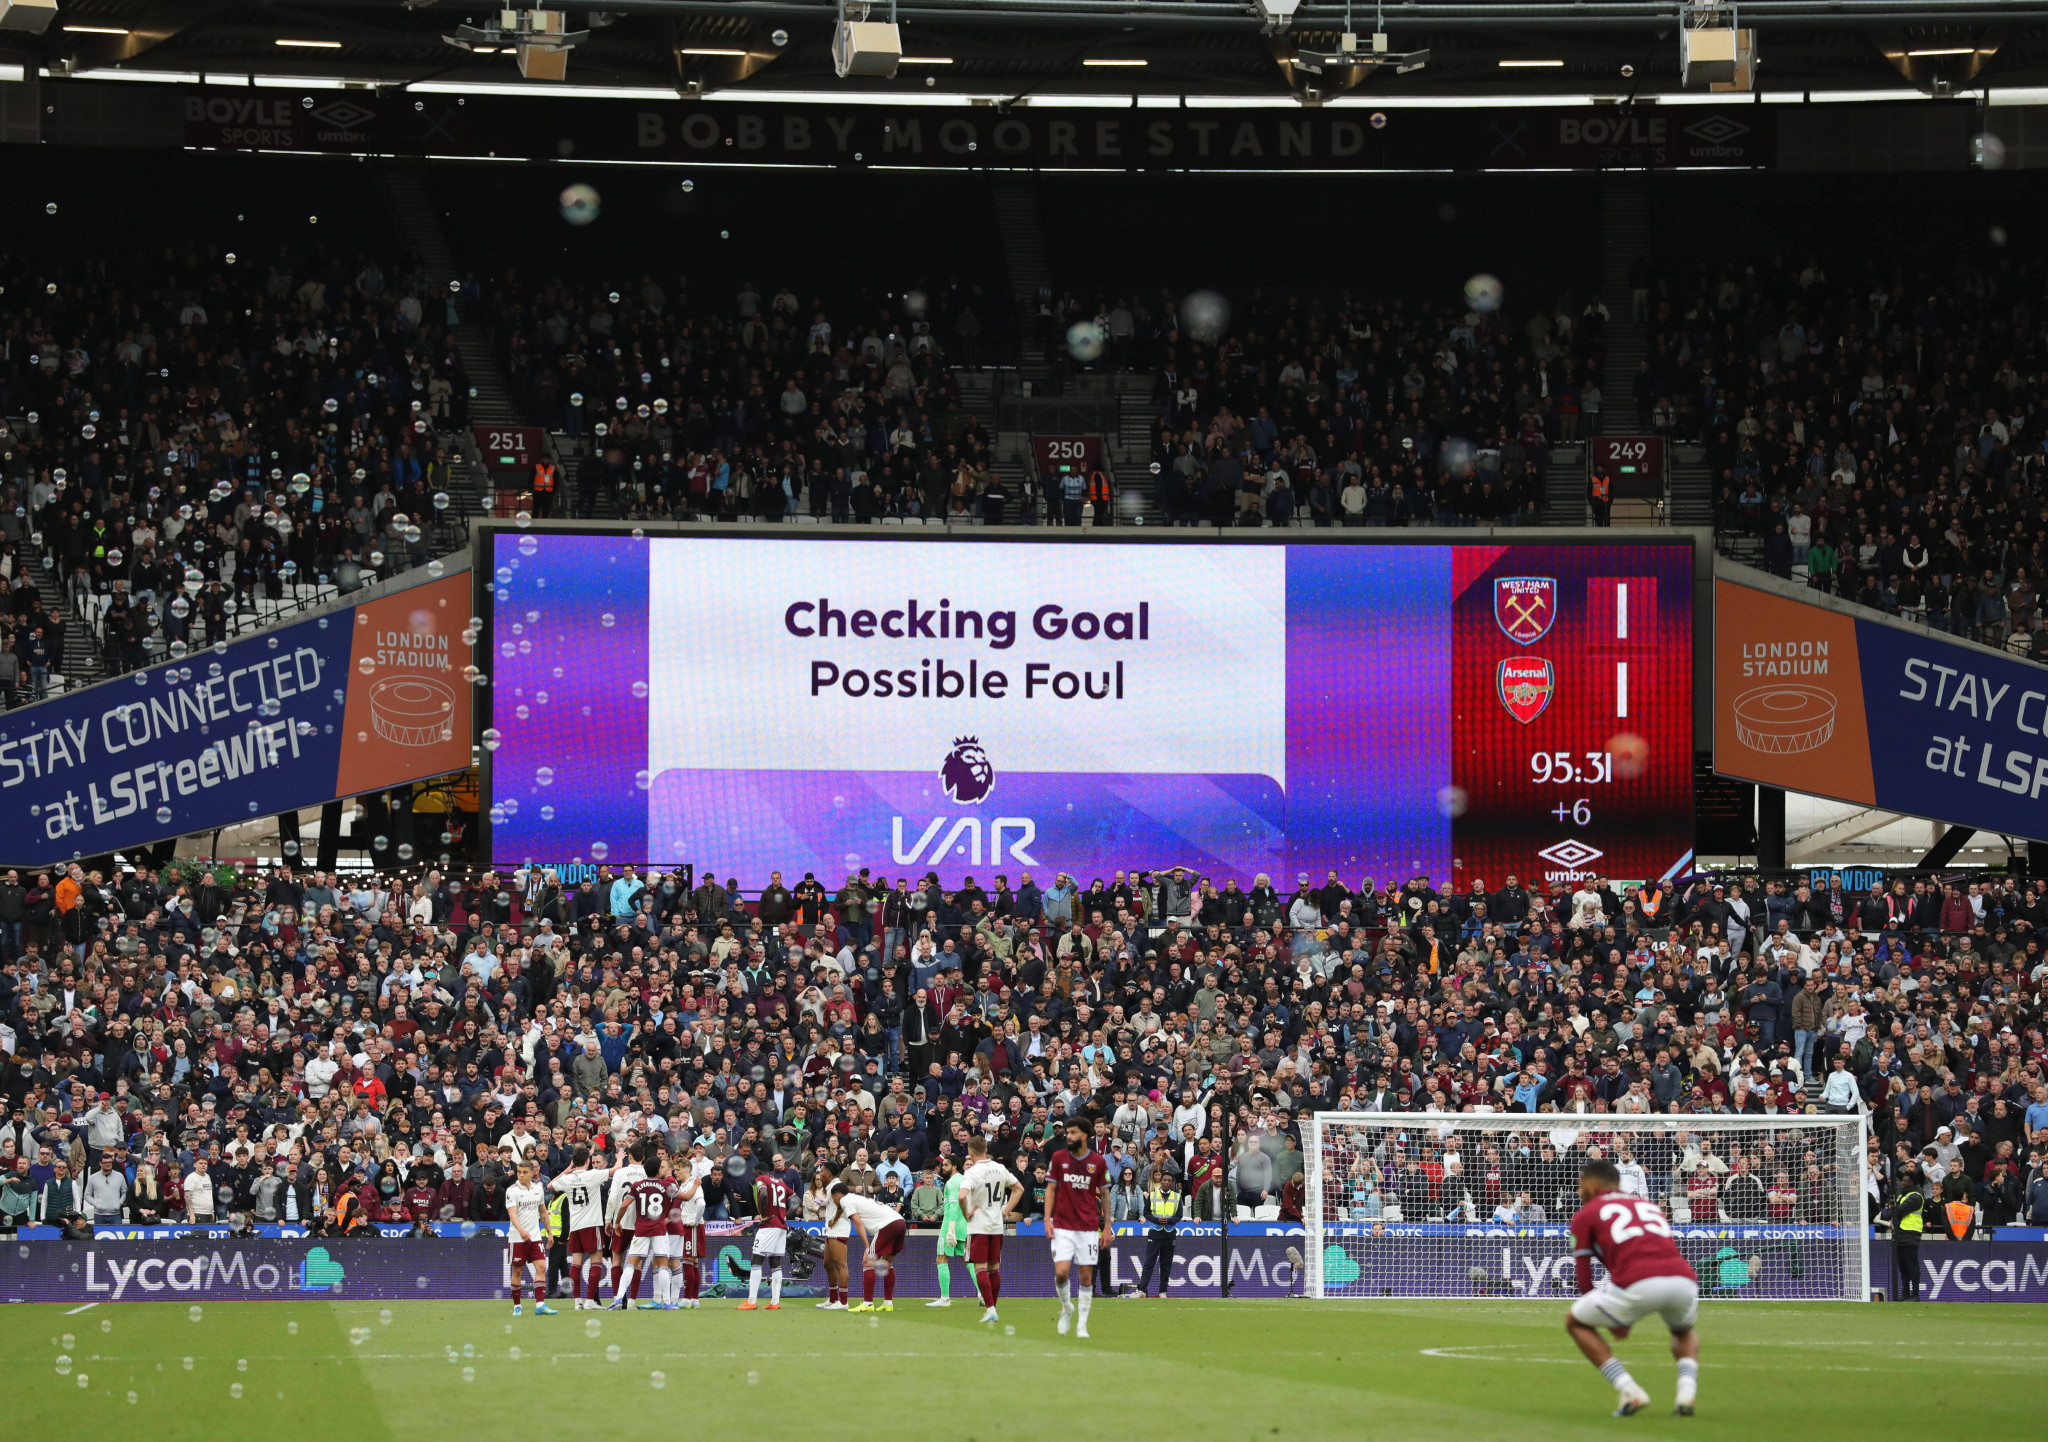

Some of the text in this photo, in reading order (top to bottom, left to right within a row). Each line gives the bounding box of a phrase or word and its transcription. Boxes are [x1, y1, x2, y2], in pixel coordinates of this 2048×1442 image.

[184, 97, 292, 126] BOYLE
[222, 128, 293, 146] SPORTS
[636, 113, 1365, 157] BOBBY MOORE STAND
[1559, 117, 1667, 144] BOYLE
[1597, 146, 1666, 164] SPORS
[1690, 145, 1744, 158] umbro
[489, 432, 526, 451] 251
[1048, 441, 1085, 459] 250
[1609, 442, 1647, 459] 249
[1502, 580, 1550, 589] WEST HAM
[1617, 583, 1627, 639] 1
[785, 598, 1149, 650] Checking Goal
[377, 631, 449, 650] LONDON
[1743, 641, 1828, 659] LONDON
[376, 650, 449, 669] STADIUM
[1743, 659, 1828, 677] STADIUM
[811, 659, 1124, 699] Possible Foul
[1504, 667, 1546, 678] Arsenal
[1617, 662, 1627, 717] 1
[1900, 657, 2010, 722] STAY
[1, 647, 321, 788] STAY CONNECTED
[1531, 752, 1612, 783] 95:31
[1926, 735, 1971, 778] at
[45, 789, 84, 840] at
[1551, 799, 1592, 826] +6
[892, 816, 1039, 865] VAR
[1811, 870, 1883, 891] BRWDOG
[1064, 1174, 1091, 1184] BOYLE
[573, 1186, 589, 1208] 41
[639, 1193, 663, 1216] 18
[770, 1183, 787, 1208] 12
[985, 1181, 1002, 1207] 14
[1600, 1202, 1672, 1244] 25
[685, 1241, 692, 1251] 8
[1088, 1244, 1098, 1256] 19
[1911, 1253, 2048, 1299] ycaM
